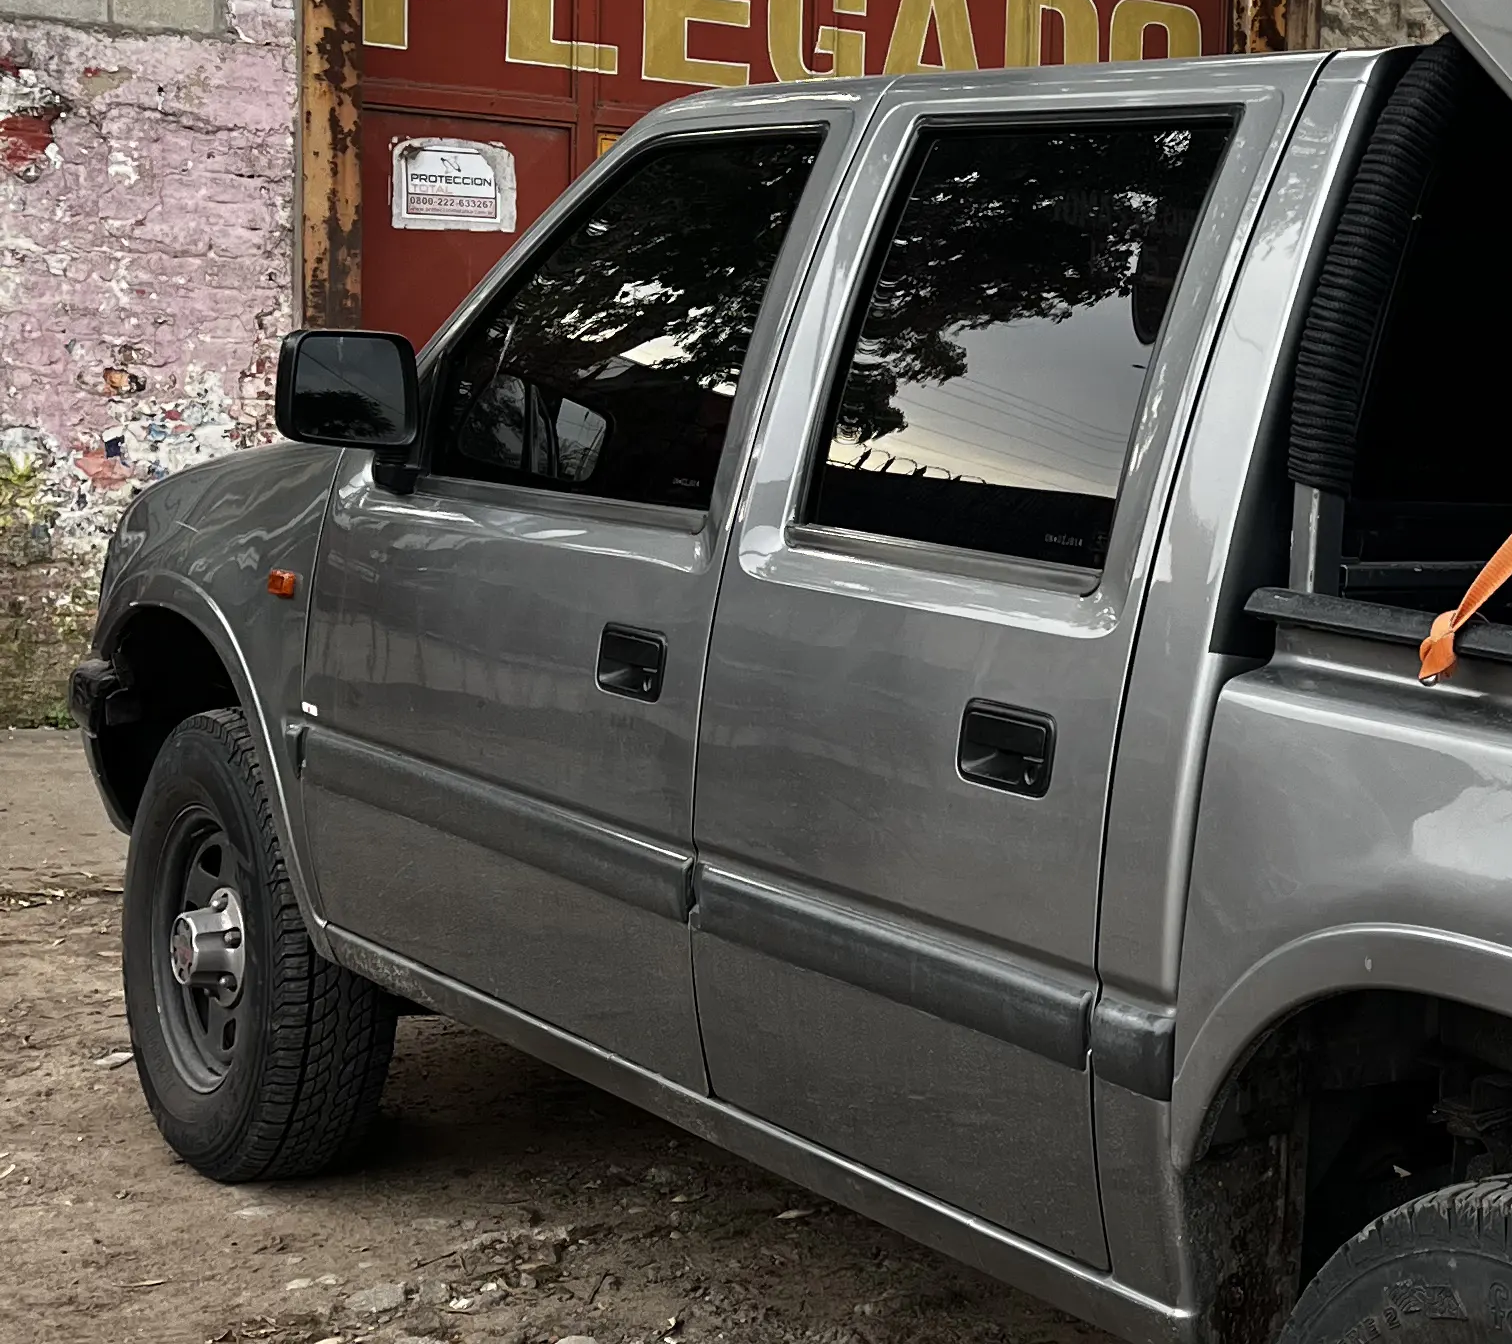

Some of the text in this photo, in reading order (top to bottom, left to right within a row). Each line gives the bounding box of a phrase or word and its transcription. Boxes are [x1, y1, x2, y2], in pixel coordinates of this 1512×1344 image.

[410, 173, 492, 187] PROTECCION
[411, 184, 453, 194] TOTAL
[1382, 1305, 1401, 1330] 2
